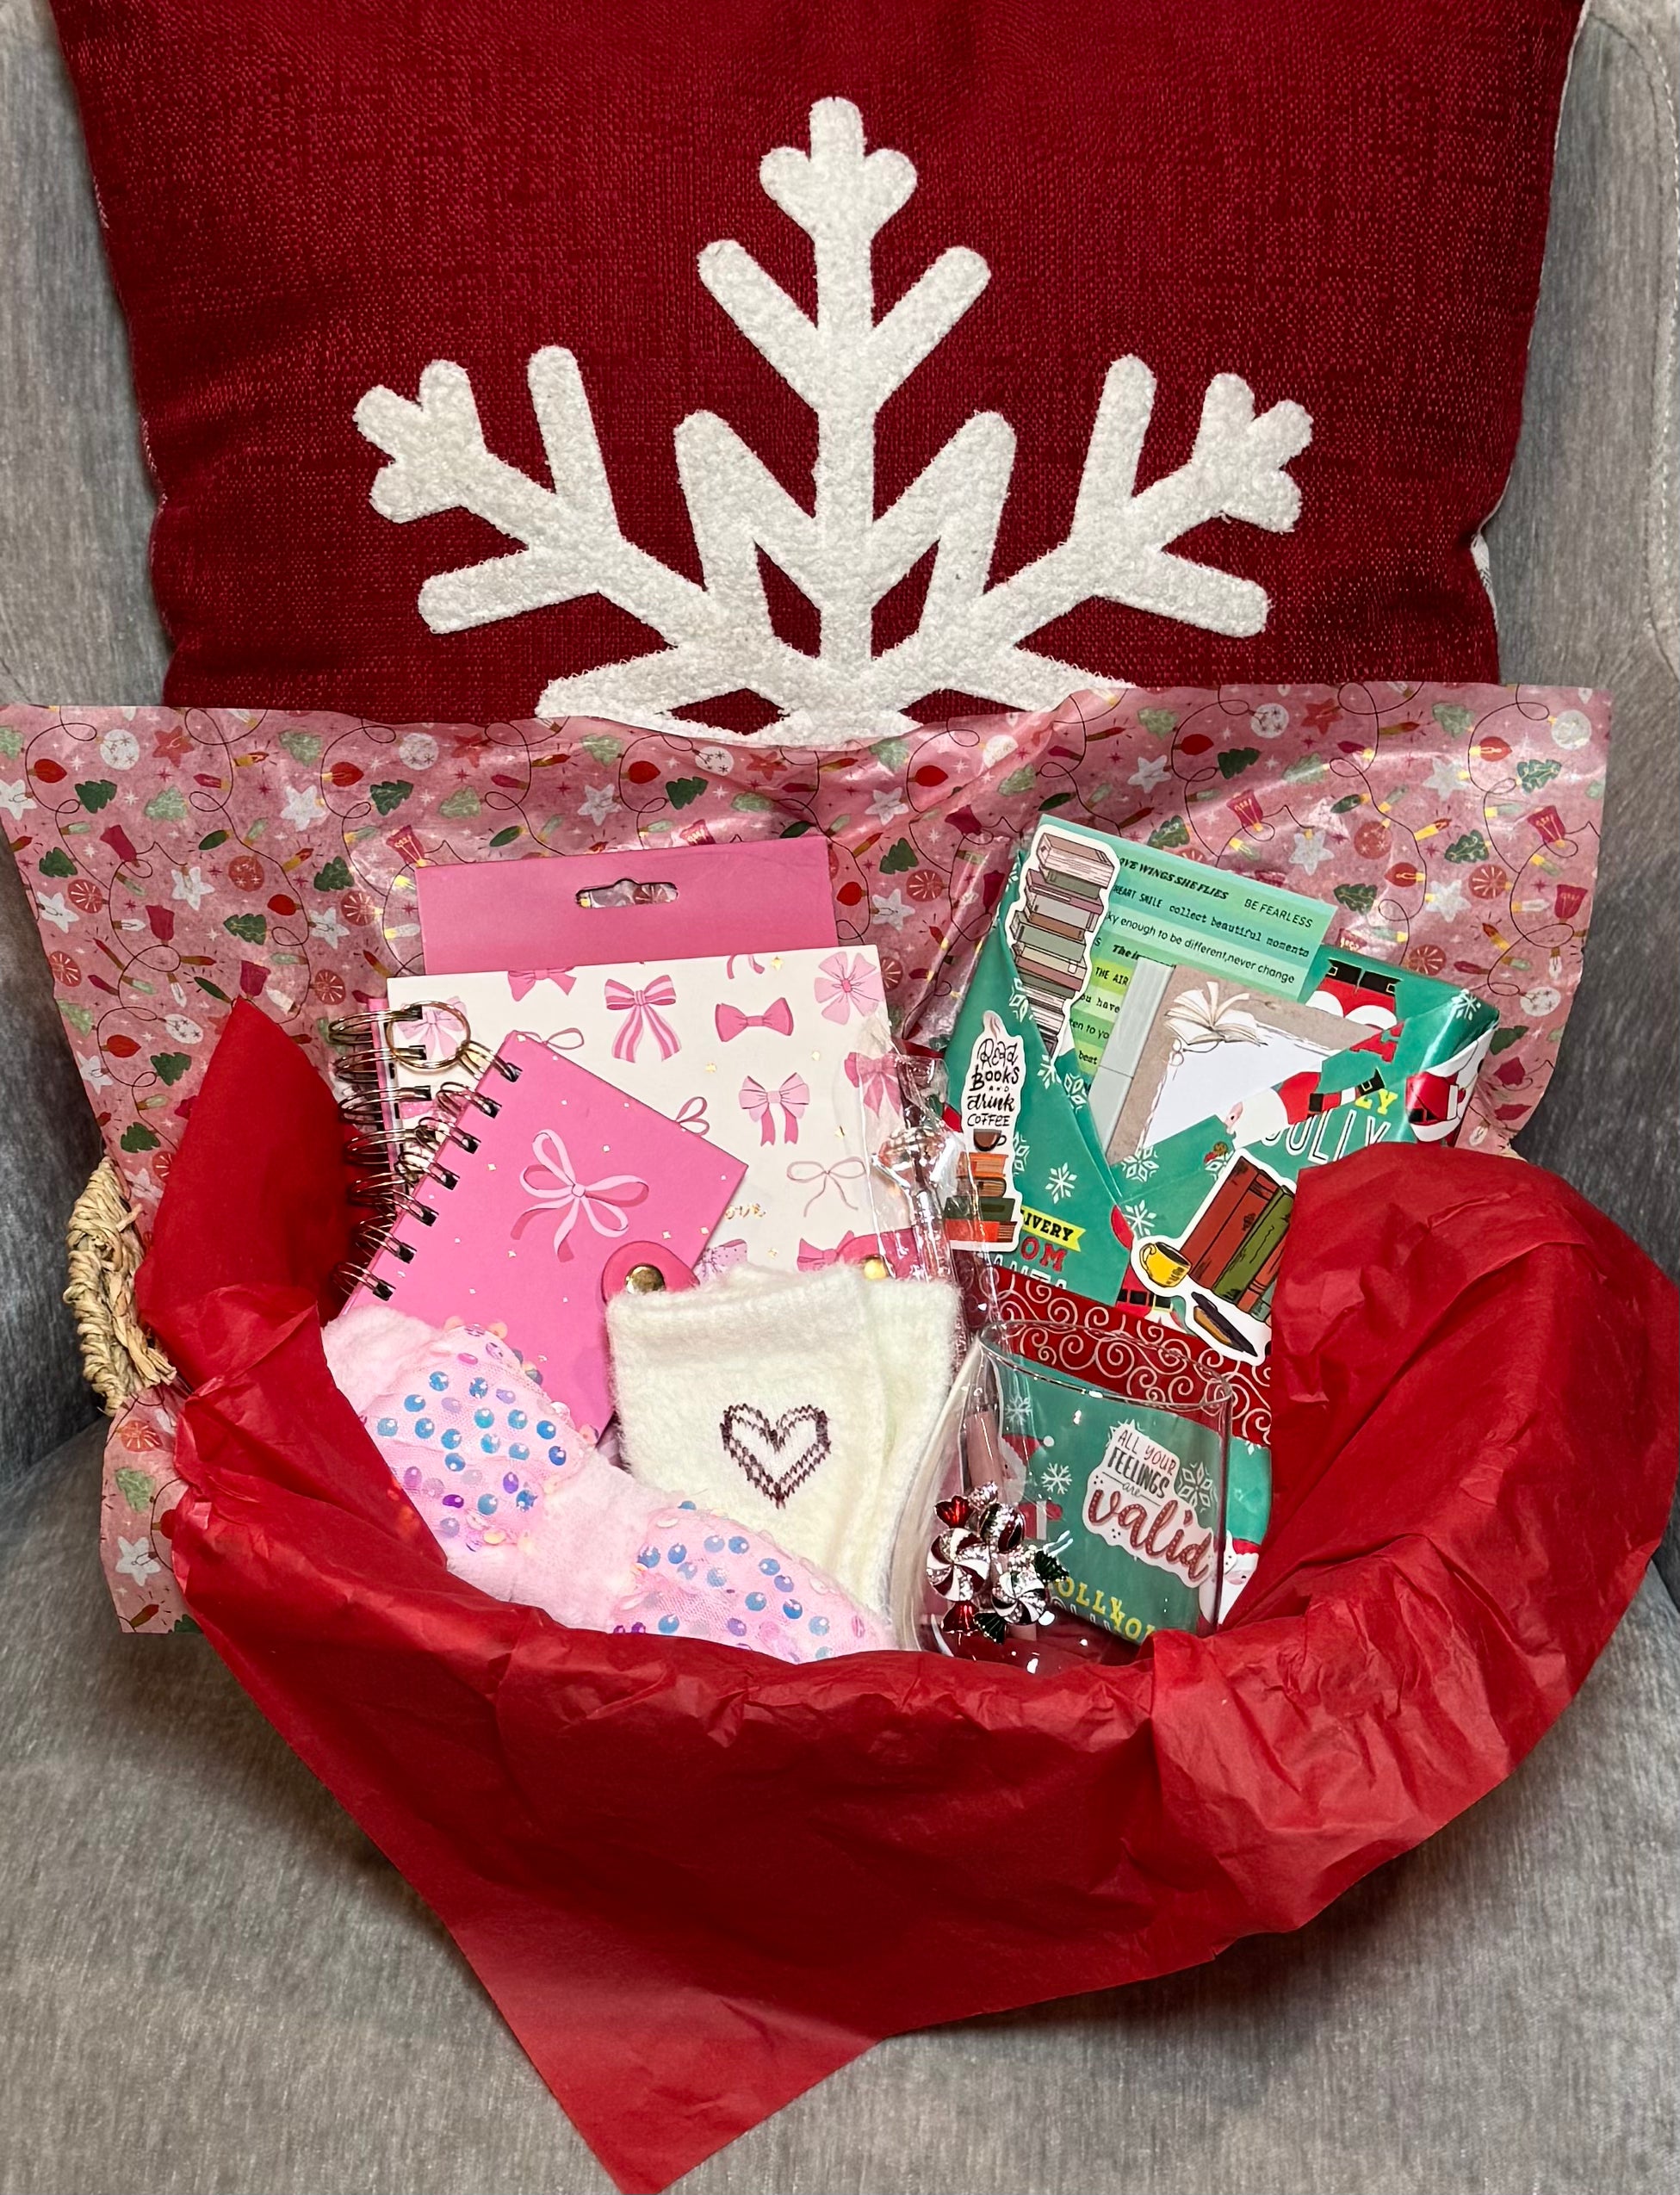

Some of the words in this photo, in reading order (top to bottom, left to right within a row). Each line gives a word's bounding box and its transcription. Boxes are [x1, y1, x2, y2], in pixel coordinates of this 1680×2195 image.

[1139, 864, 1175, 882] WINGS
[1174, 876, 1198, 890] SHE
[1197, 883, 1229, 900] FLIES
[1139, 893, 1162, 908] SMILE
[1244, 898, 1259, 910] BE
[1259, 903, 1313, 928] FEARLESS
[1169, 905, 1207, 923] collect
[1211, 916, 1262, 942] beautiful
[1112, 944, 1132, 958] The
[1120, 918, 1156, 936] enough
[1157, 930, 1169, 940] to
[1170, 933, 1182, 945] be
[1257, 964, 1295, 983] change
[1094, 966, 1109, 980] THE
[1112, 973, 1129, 986] AIR
[1095, 997, 1120, 1014] have
[1086, 1023, 1096, 1035] to
[967, 1093, 1015, 1112] drink
[1020, 1209, 1074, 1242] IVERY
[1118, 1429, 1139, 1454] ALL
[1107, 1447, 1171, 1499] FEELINGS
[1088, 1488, 1212, 1583] valid
